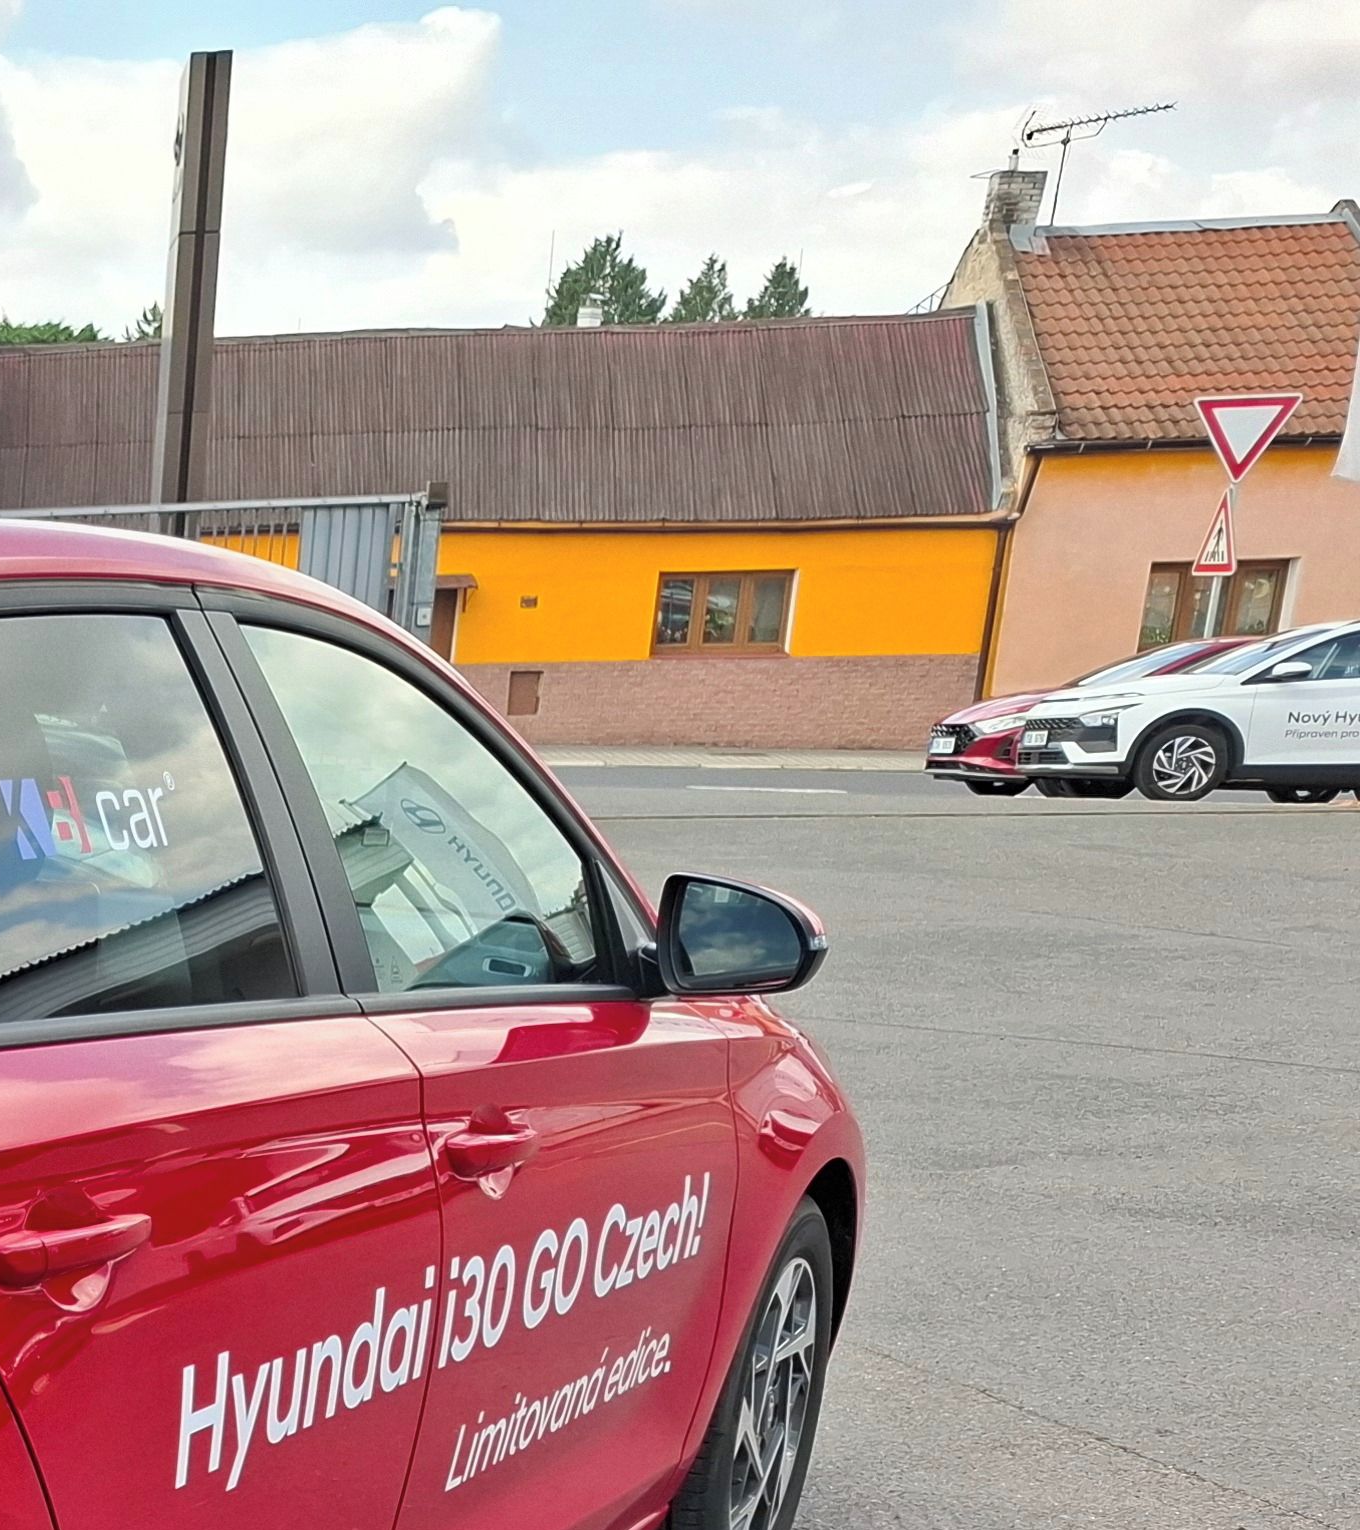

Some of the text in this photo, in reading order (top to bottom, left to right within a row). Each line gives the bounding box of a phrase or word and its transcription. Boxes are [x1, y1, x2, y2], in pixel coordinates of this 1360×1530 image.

[1288, 709, 1331, 726] Nový
[447, 834, 516, 912] HYUND
[175, 1172, 711, 1491] Hyundai i30 GO Czech!
[444, 1325, 672, 1492] Limitovaná edice.
